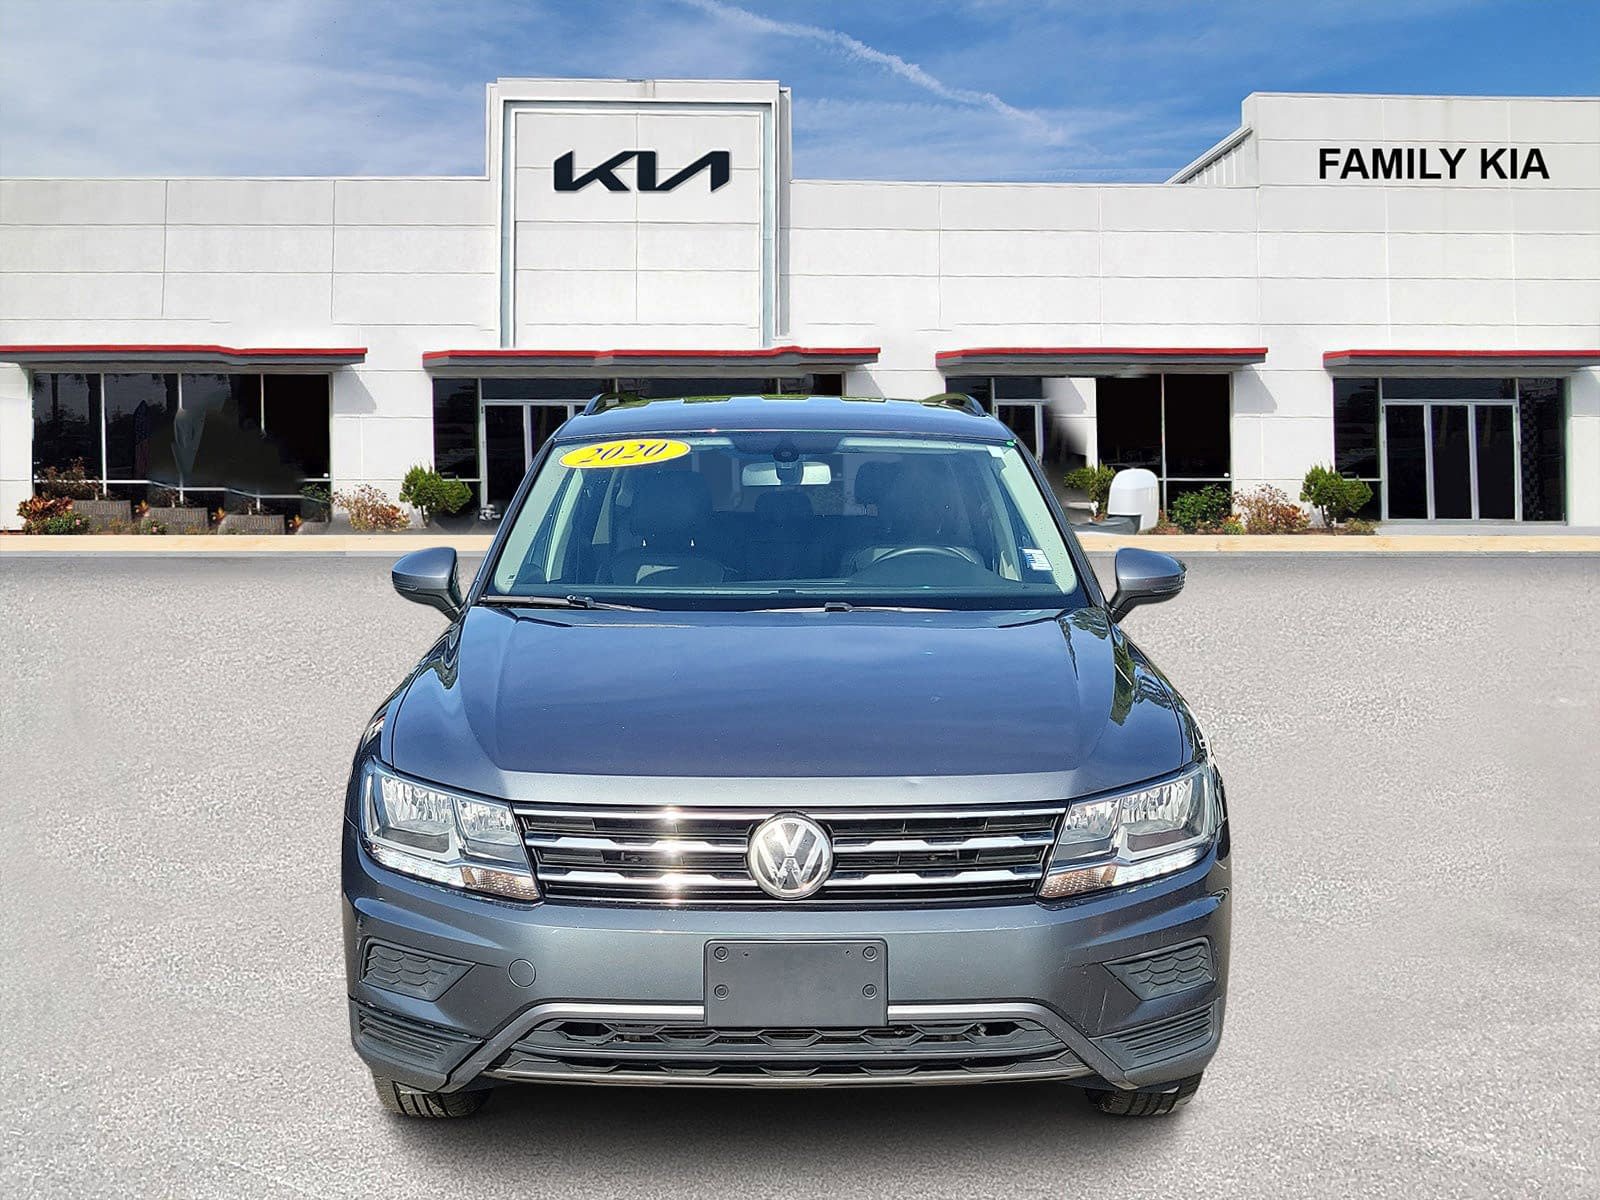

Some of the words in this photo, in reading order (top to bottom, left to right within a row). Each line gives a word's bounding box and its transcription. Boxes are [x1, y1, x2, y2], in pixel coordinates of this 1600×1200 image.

[1319, 148, 1467, 179] FAMILY
[1480, 148, 1550, 179] KIA
[577, 441, 669, 464] 2020
